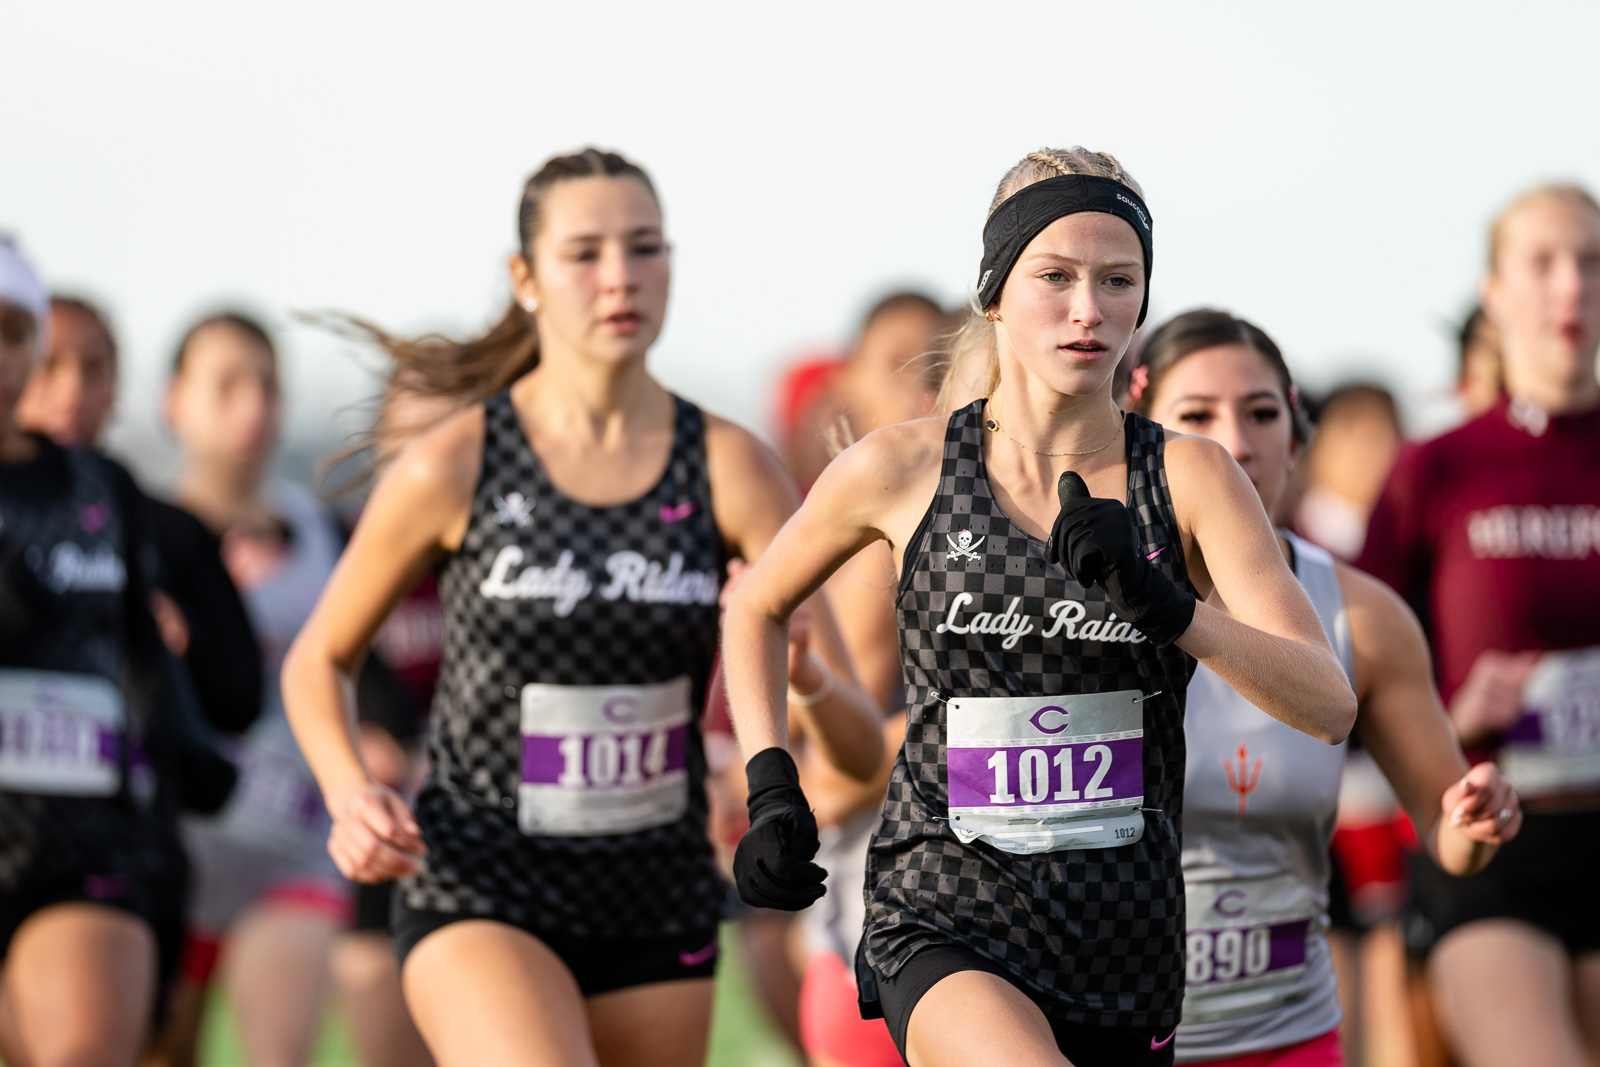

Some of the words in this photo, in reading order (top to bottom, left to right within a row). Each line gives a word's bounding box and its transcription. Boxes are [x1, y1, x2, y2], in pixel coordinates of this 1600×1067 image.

[480, 545, 592, 617] Lady
[936, 592, 1033, 650] Lady
[1029, 705, 1069, 734] C
[987, 744, 1113, 804] 1012
[1114, 827, 1136, 839] 1012
[1186, 925, 1271, 984] 890
